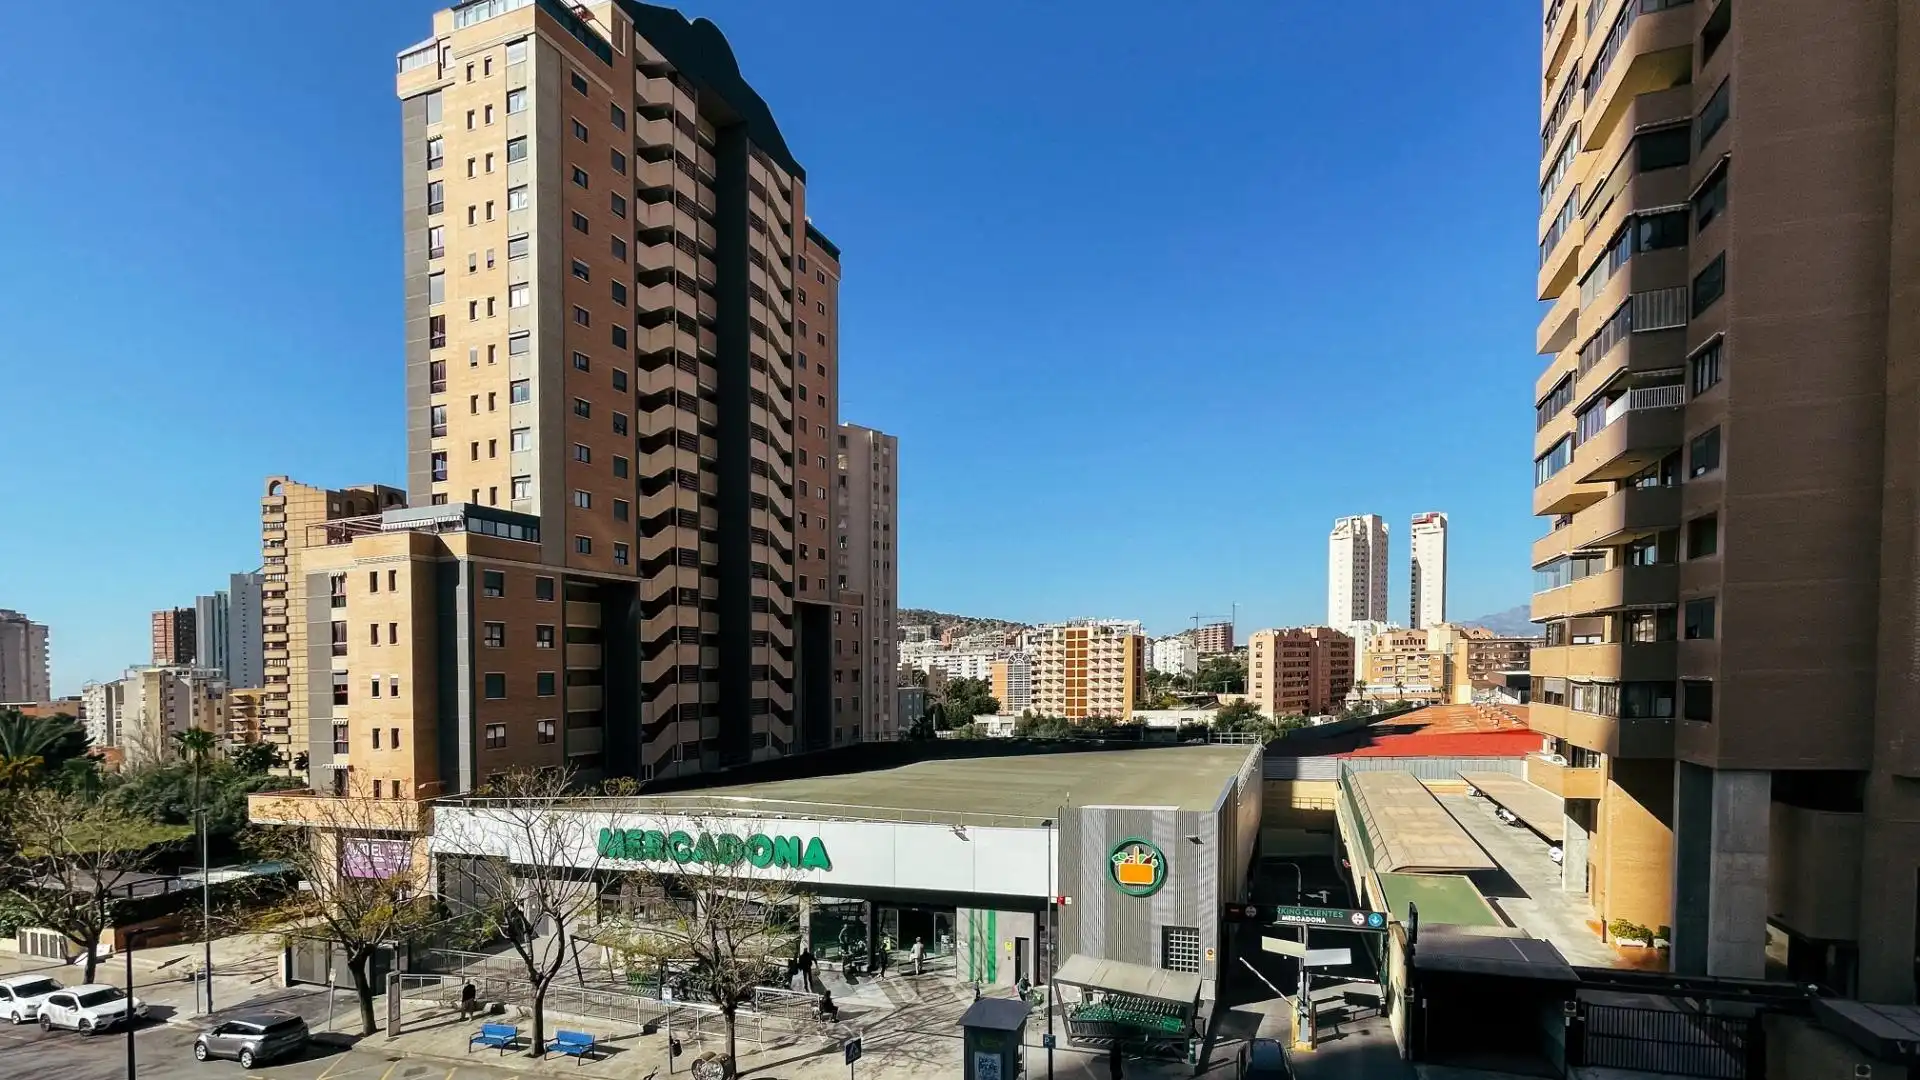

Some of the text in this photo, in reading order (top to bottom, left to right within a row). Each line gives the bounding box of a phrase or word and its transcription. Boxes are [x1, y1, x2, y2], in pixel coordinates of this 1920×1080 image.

[597, 827, 832, 871] MERCADONA
[1303, 909, 1343, 918] CLIENTES
[1281, 915, 1327, 924] MERCADONA
